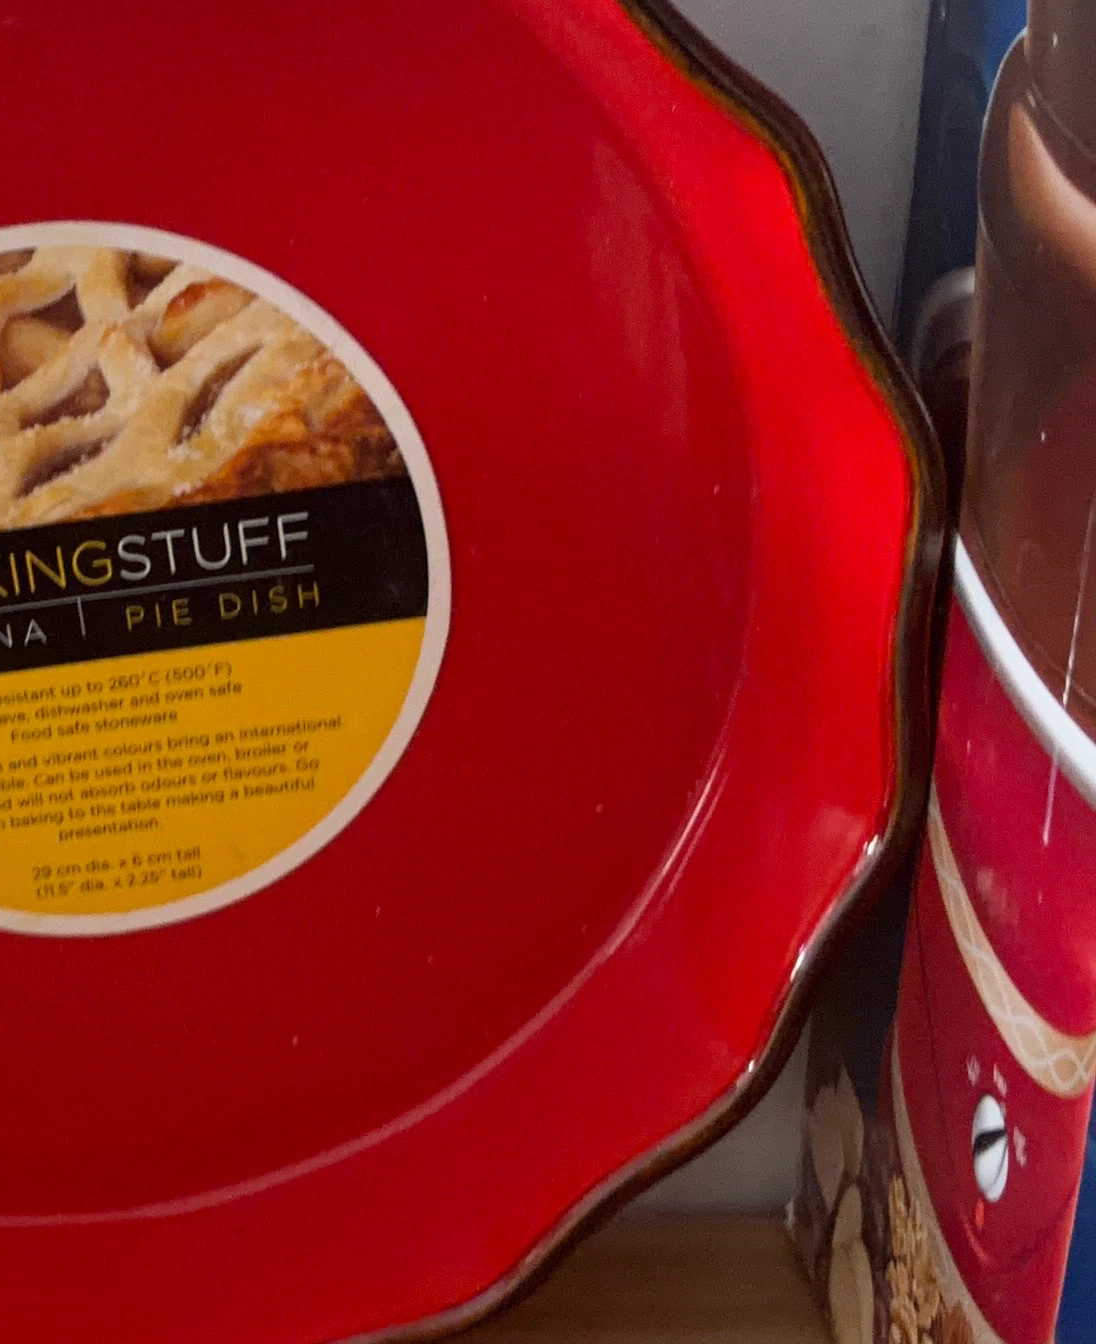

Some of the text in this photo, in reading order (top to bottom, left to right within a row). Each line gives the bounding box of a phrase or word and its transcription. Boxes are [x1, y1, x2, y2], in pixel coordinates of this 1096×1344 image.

[124, 597, 193, 632] PIE
[218, 580, 322, 621] DISH
[36, 698, 124, 721] dishwasher
[130, 691, 160, 706] and
[165, 687, 204, 702] oven
[209, 681, 242, 697] safe
[61, 684, 82, 698] up
[86, 681, 103, 693] to
[9, 756, 37, 772] and
[43, 748, 98, 767] vibrant
[104, 739, 163, 758] colours
[168, 732, 210, 751] bring
[215, 731, 234, 744] an
[239, 715, 342, 739] international
[11, 710, 178, 743] Food safe stoneware
[18, 791, 43, 808] will
[48, 788, 73, 803] not
[80, 782, 135, 801] absorb
[141, 774, 197, 793] odours
[201, 770, 217, 784] or
[295, 757, 319, 773] Go
[33, 772, 64, 787] Can
[69, 768, 90, 782] be
[95, 763, 132, 778] used
[138, 759, 152, 773] in
[157, 754, 183, 770] the
[235, 742, 287, 761] broiler
[293, 740, 309, 753] or
[10, 808, 64, 828] baking
[69, 804, 85, 819] to
[90, 800, 119, 817] the
[120, 794, 161, 813] table
[166, 786, 224, 807] making
[230, 788, 240, 800] a
[244, 777, 315, 798] beautiful
[59, 817, 158, 843] presentation
[32, 865, 52, 881] 29
[57, 863, 81, 876] cm
[119, 858, 127, 869] x
[132, 854, 142, 868] 6
[147, 852, 172, 864] cm
[176, 845, 201, 860] tall
[113, 877, 121, 888] x
